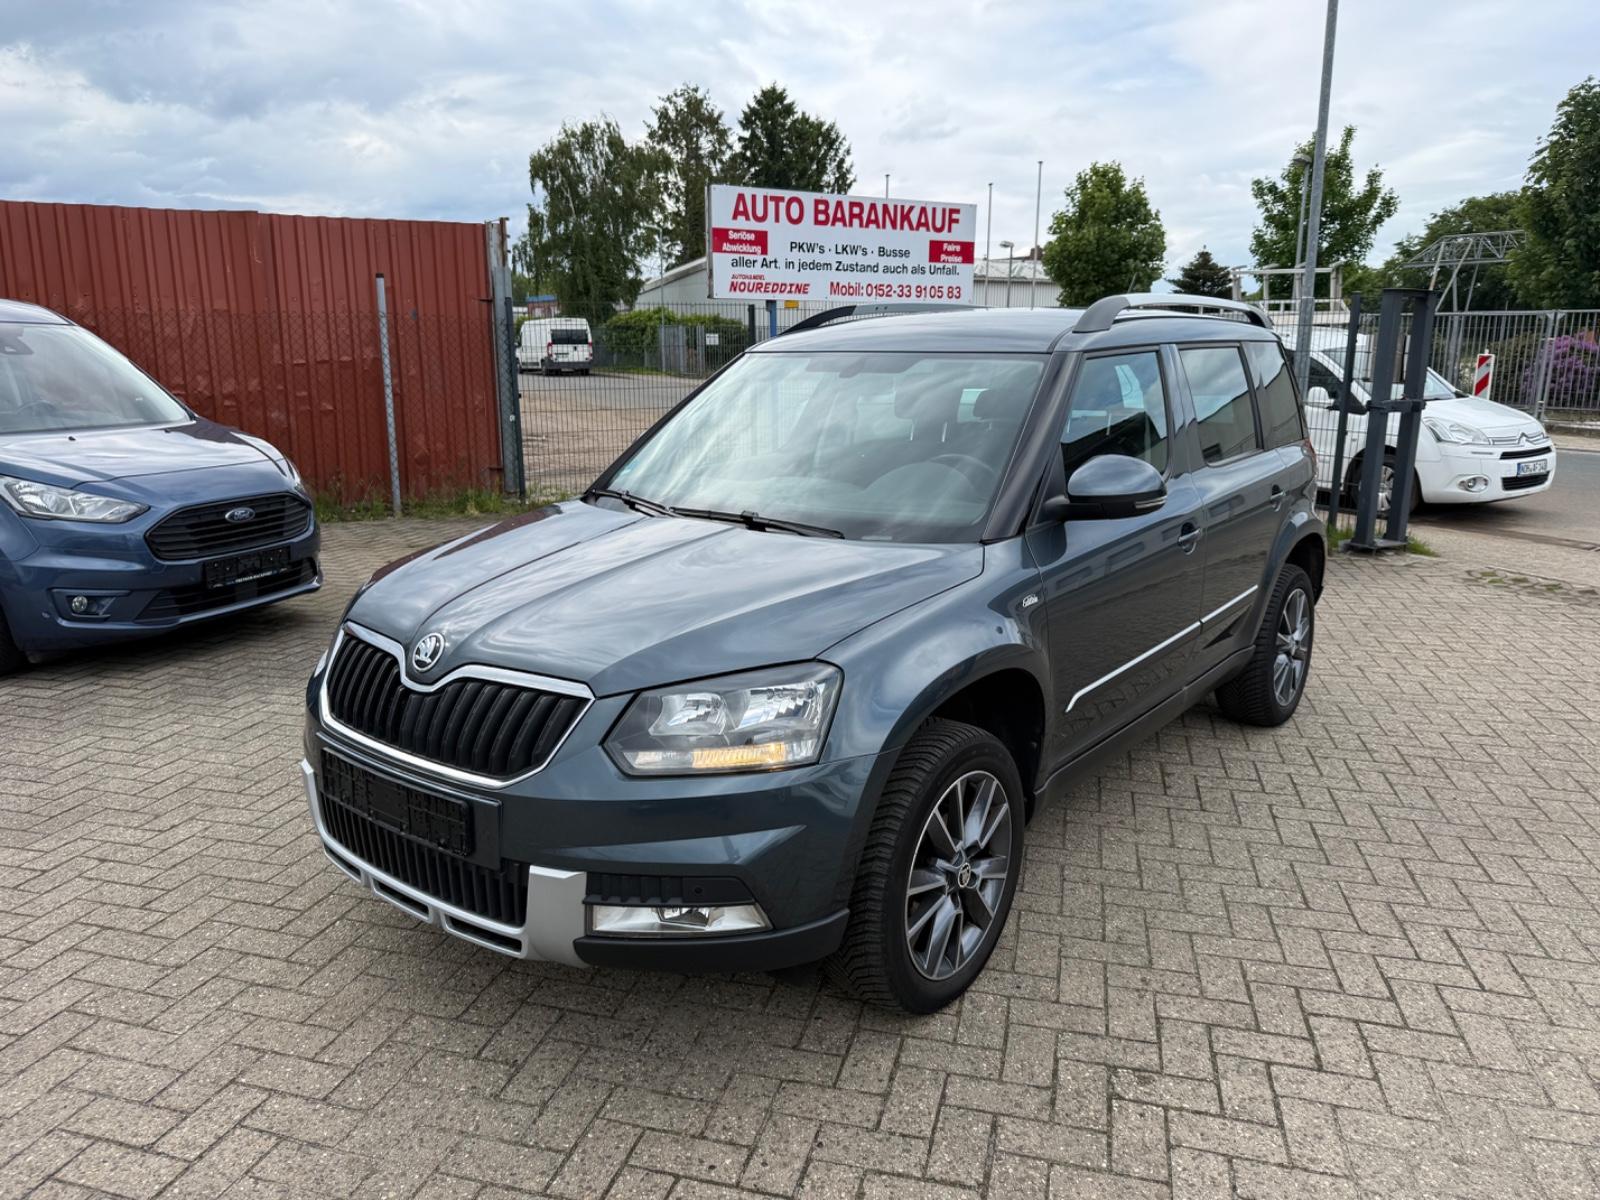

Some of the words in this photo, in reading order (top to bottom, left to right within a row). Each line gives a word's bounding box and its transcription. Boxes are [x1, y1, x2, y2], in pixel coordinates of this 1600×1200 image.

[731, 192, 805, 225] AUTO
[813, 198, 961, 234] BARANKAUF
[728, 230, 755, 241] Seriöse
[722, 242, 762, 256] Abwicklung
[789, 241, 826, 255] PKW's
[834, 243, 868, 257] LKW's
[877, 246, 911, 258] Busse
[942, 242, 961, 252] Faire
[940, 254, 963, 263] Preise
[730, 256, 758, 269] aller
[784, 258, 795, 270] in
[797, 259, 832, 273] jedem
[835, 261, 879, 274] Zustand
[882, 263, 908, 275] auch
[911, 264, 926, 275] als
[928, 264, 960, 276] Unfall.
[729, 281, 811, 295] NOUREDDINE
[946, 286, 961, 299] 83
